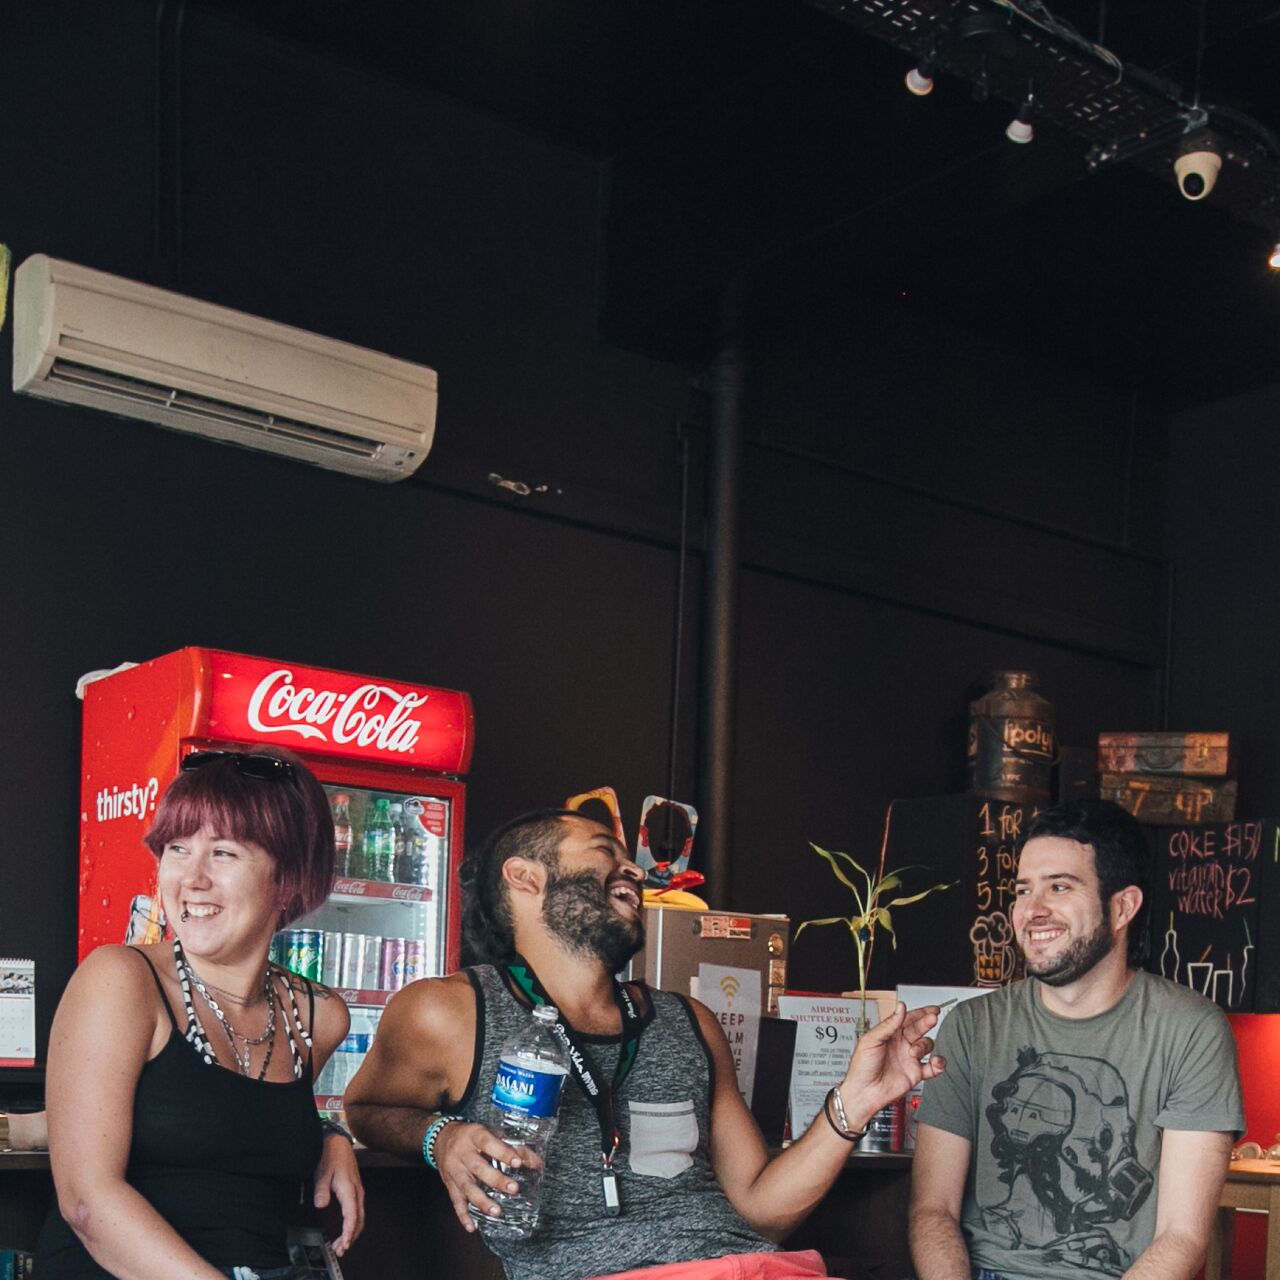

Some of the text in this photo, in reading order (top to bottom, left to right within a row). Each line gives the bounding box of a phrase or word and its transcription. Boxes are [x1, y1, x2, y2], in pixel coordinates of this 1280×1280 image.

[248, 670, 428, 752] Coca-Cola
[96, 777, 159, 822] thirsty?
[978, 802, 995, 836] 1
[977, 847, 988, 876] 3
[977, 881, 991, 911] 5
[790, 1014, 832, 1023] SHUTTLE
[811, 1006, 851, 1014] AIRPORT
[815, 1025, 838, 1044] $9
[496, 1073, 534, 1095] DASANI
